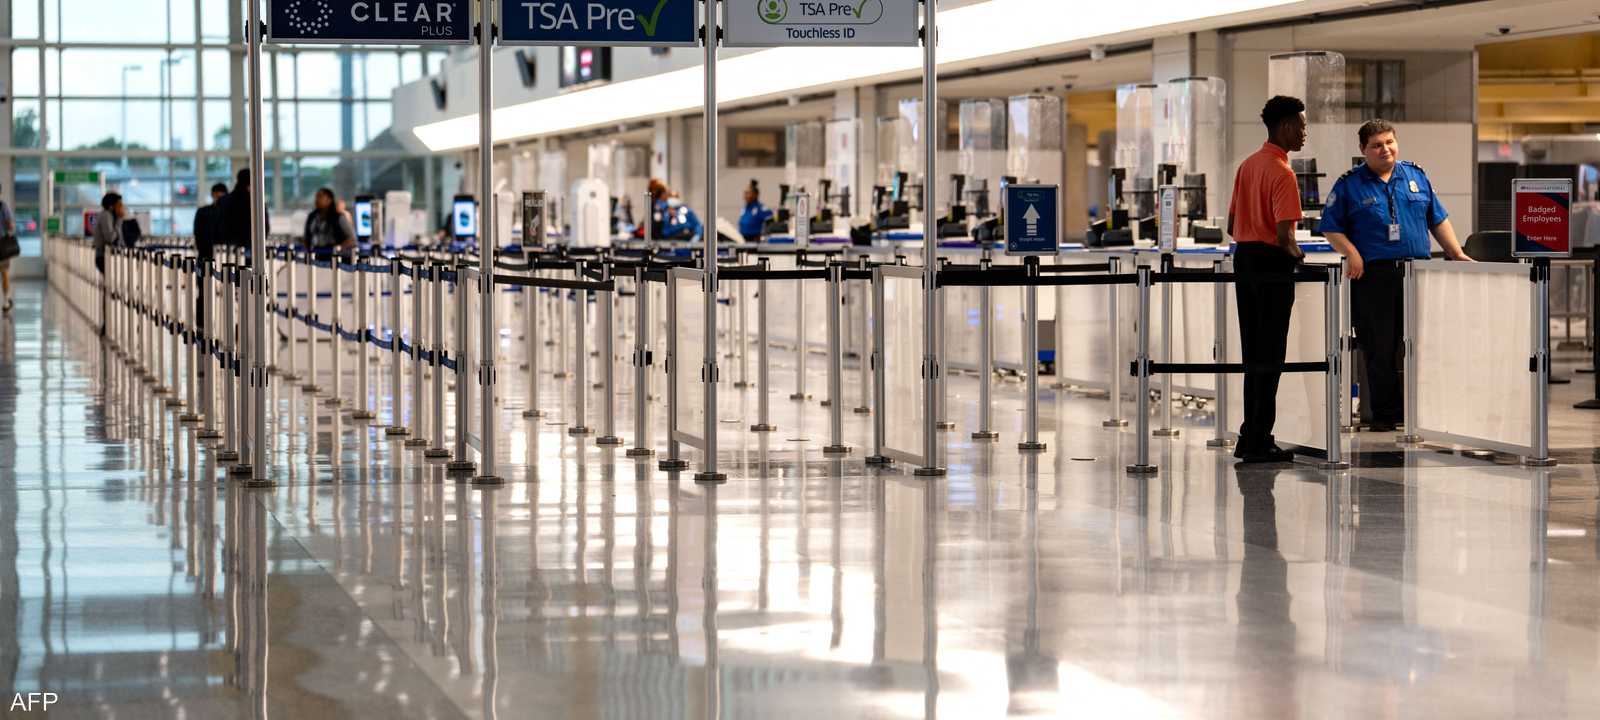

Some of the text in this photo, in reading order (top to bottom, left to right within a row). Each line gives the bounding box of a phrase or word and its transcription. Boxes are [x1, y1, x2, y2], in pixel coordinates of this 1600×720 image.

[350, 2, 452, 22] CLEAR
[800, 2, 851, 16] TSA Pre
[521, 2, 635, 30] TSA Pre
[421, 25, 453, 36] PLUS
[786, 27, 855, 39] Touchless ID
[1528, 206, 1556, 214] Badged
[1522, 215, 1561, 223] Employees
